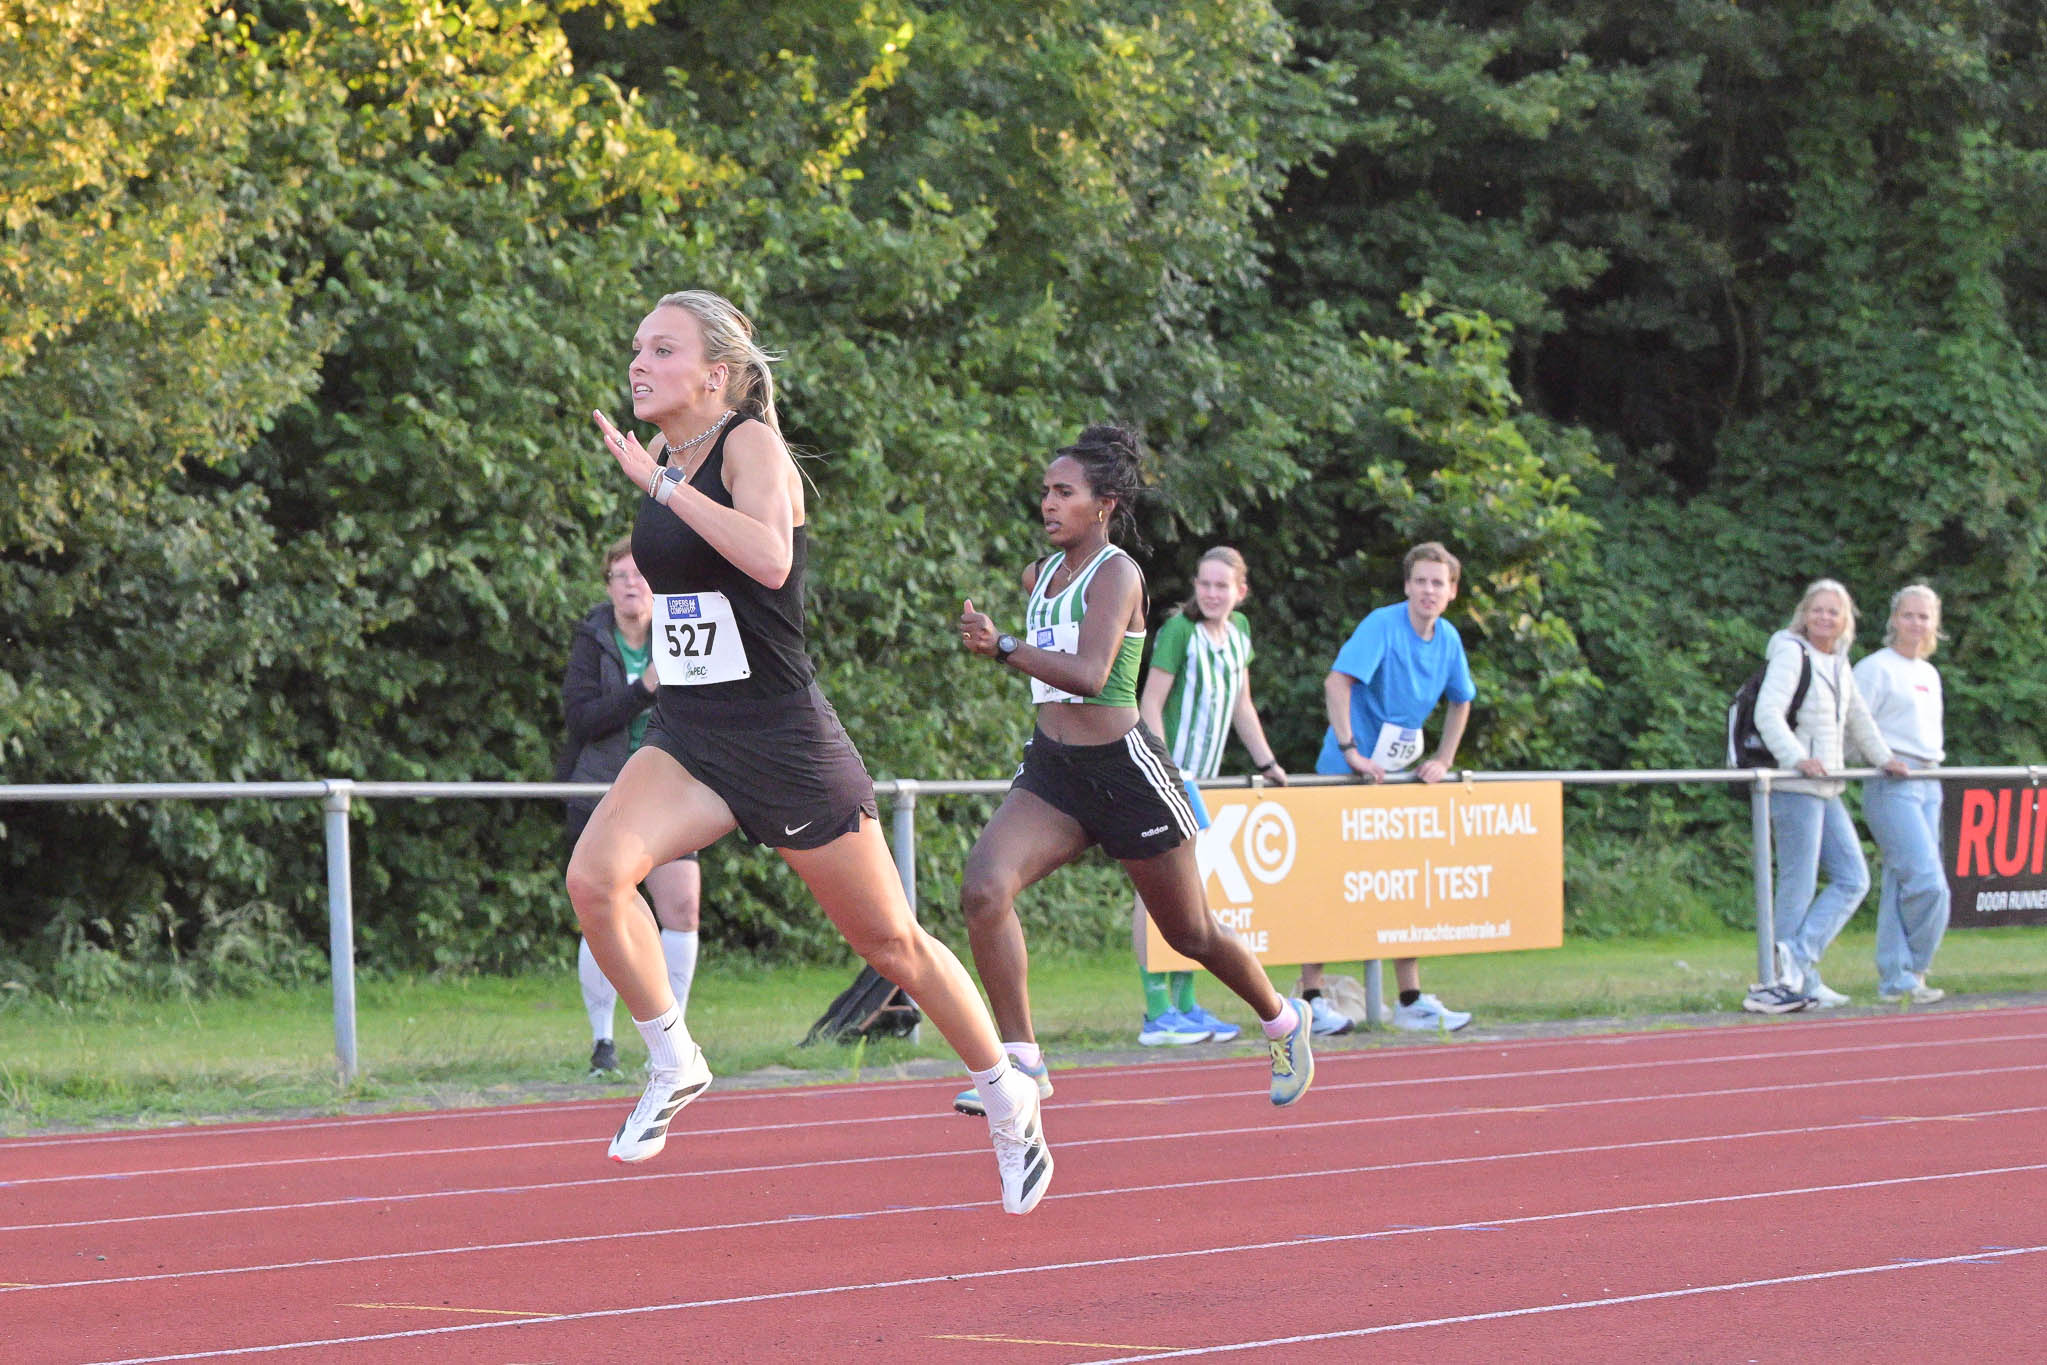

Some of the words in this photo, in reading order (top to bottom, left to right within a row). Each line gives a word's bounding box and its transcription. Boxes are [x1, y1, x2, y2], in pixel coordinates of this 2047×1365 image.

[665, 622, 717, 657] 527
[1387, 742, 1416, 759] 519
[1141, 825, 1169, 838] adidas
[1341, 805, 1446, 841] HERSTEL
[1459, 803, 1538, 837] VITAAL
[1343, 868, 1419, 903] SPORT
[1434, 865, 1493, 900] TEST
[1976, 891, 2009, 912] DOOR
[1376, 919, 1511, 944] www.krachtcentrale.nl
